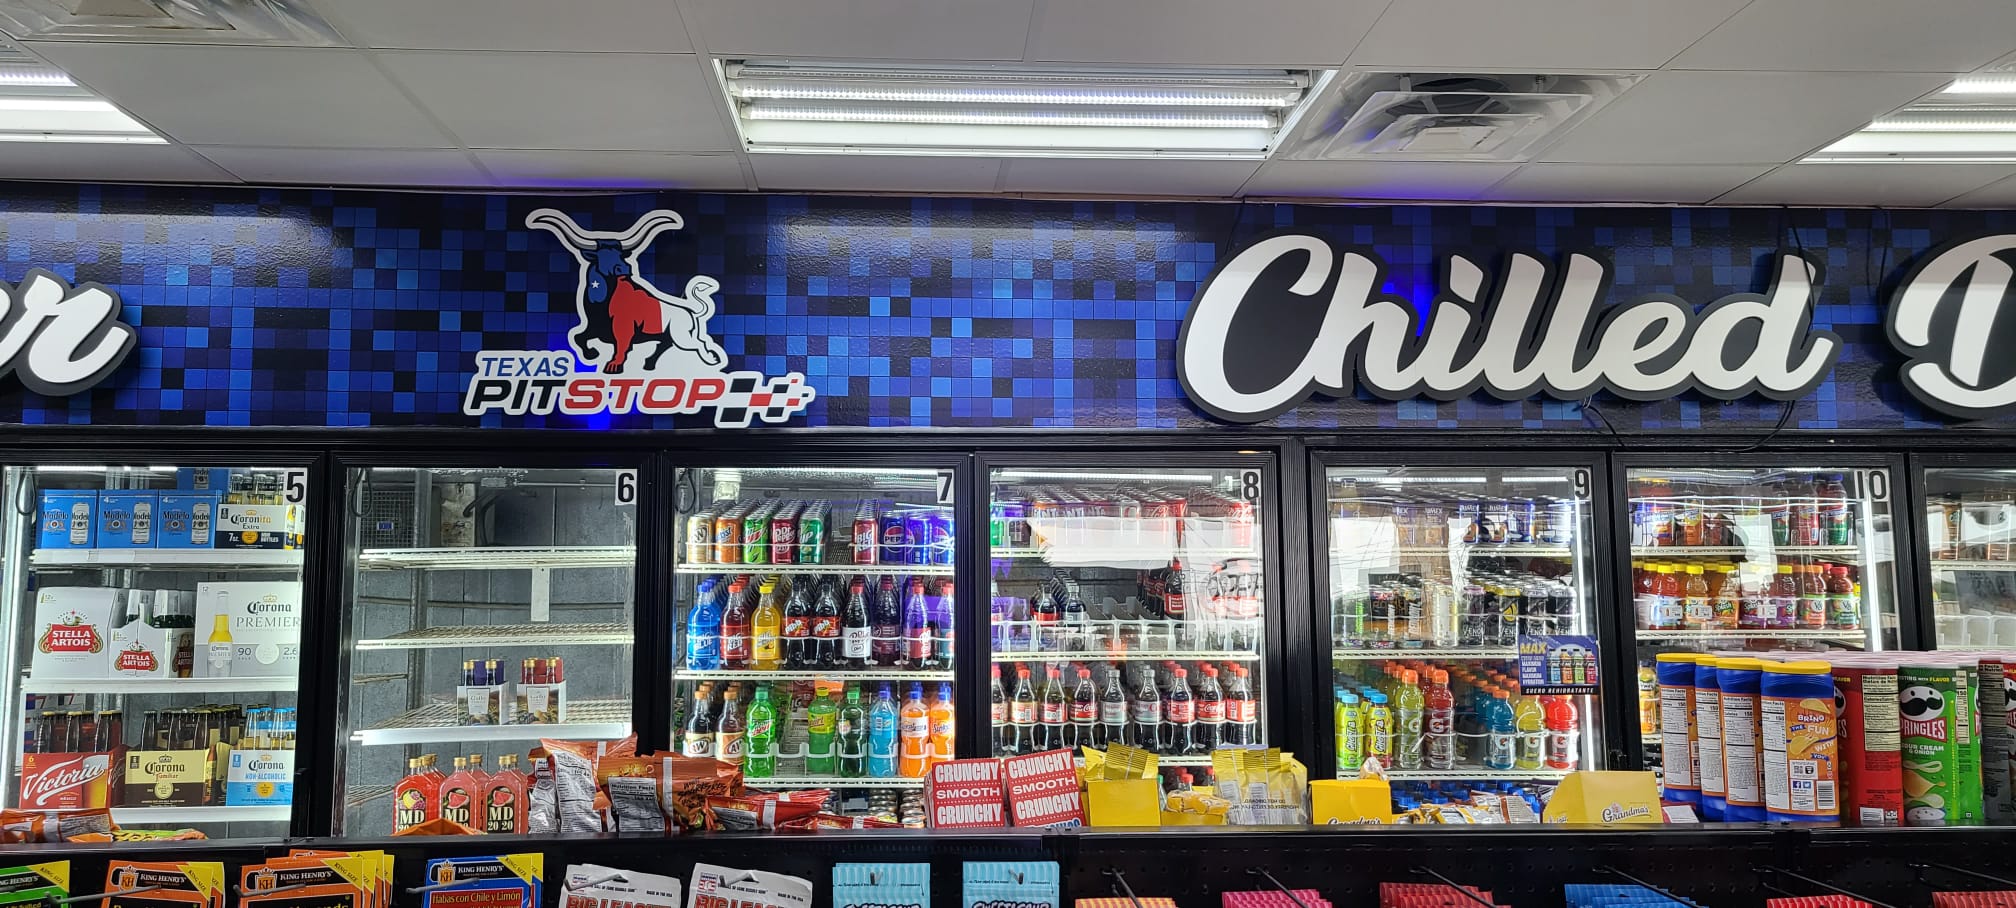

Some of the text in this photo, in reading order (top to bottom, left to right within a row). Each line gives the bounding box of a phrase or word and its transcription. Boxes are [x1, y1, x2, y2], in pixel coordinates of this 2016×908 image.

[1183, 234, 1834, 414] Chilled
[481, 357, 569, 377] TEXAS
[286, 471, 304, 503] 5
[617, 472, 634, 503] 6
[937, 471, 952, 502] 7
[1243, 472, 1259, 500] 8
[1574, 469, 1590, 499] 9
[1858, 470, 1887, 501] 10
[41, 511, 68, 520] Modelo
[103, 510, 130, 520] Modelo
[162, 511, 189, 520] Modelo
[857, 529, 872, 542] BIG
[247, 601, 292, 615] Corona
[236, 617, 300, 628] PREMIER
[52, 630, 90, 638] STELLA
[50, 638, 91, 647] ARTOIS
[1520, 643, 1547, 654] MAX
[237, 647, 252, 656] 90
[1797, 714, 1825, 722] BRING
[1429, 718, 1444, 733] G
[1807, 725, 1829, 735] FUN
[1814, 740, 1834, 752] WITH
[145, 762, 185, 775] Corona
[249, 759, 285, 771] Corona
[1008, 752, 1071, 779] CRUNCHY
[245, 772, 286, 780] NON-ALCOHOLIC
[935, 762, 999, 784] CRUNCHY
[23, 756, 106, 806] Victoria
[1012, 776, 1077, 795] SMOOTH
[936, 787, 1000, 800] SMOOTH
[1015, 791, 1080, 820] CRUNCHY
[400, 810, 425, 824] MD
[444, 809, 469, 823] MD
[489, 807, 513, 821] MD
[937, 803, 1002, 825] CRUNCHY
[1601, 806, 1649, 823] Grandma's
[487, 820, 514, 831] 20 20
[334, 862, 358, 882] KING SIZE
[458, 865, 504, 874] KING HENRY'S
[504, 857, 527, 876] KING SIZE
[9, 875, 39, 885] HENRY'S
[40, 866, 65, 884] KING SIZE
[140, 873, 186, 883] KING HENRY'S
[188, 869, 207, 890] KING SIZE
[280, 871, 333, 881] KING HENRY'S
[121, 878, 134, 888] KH
[259, 878, 274, 889] KH
[432, 894, 454, 904] Habas
[470, 891, 491, 903] Chile
[490, 895, 496, 904] y
[496, 890, 521, 900] Limón
[566, 894, 599, 908] BIG
[694, 893, 729, 908] BIG
